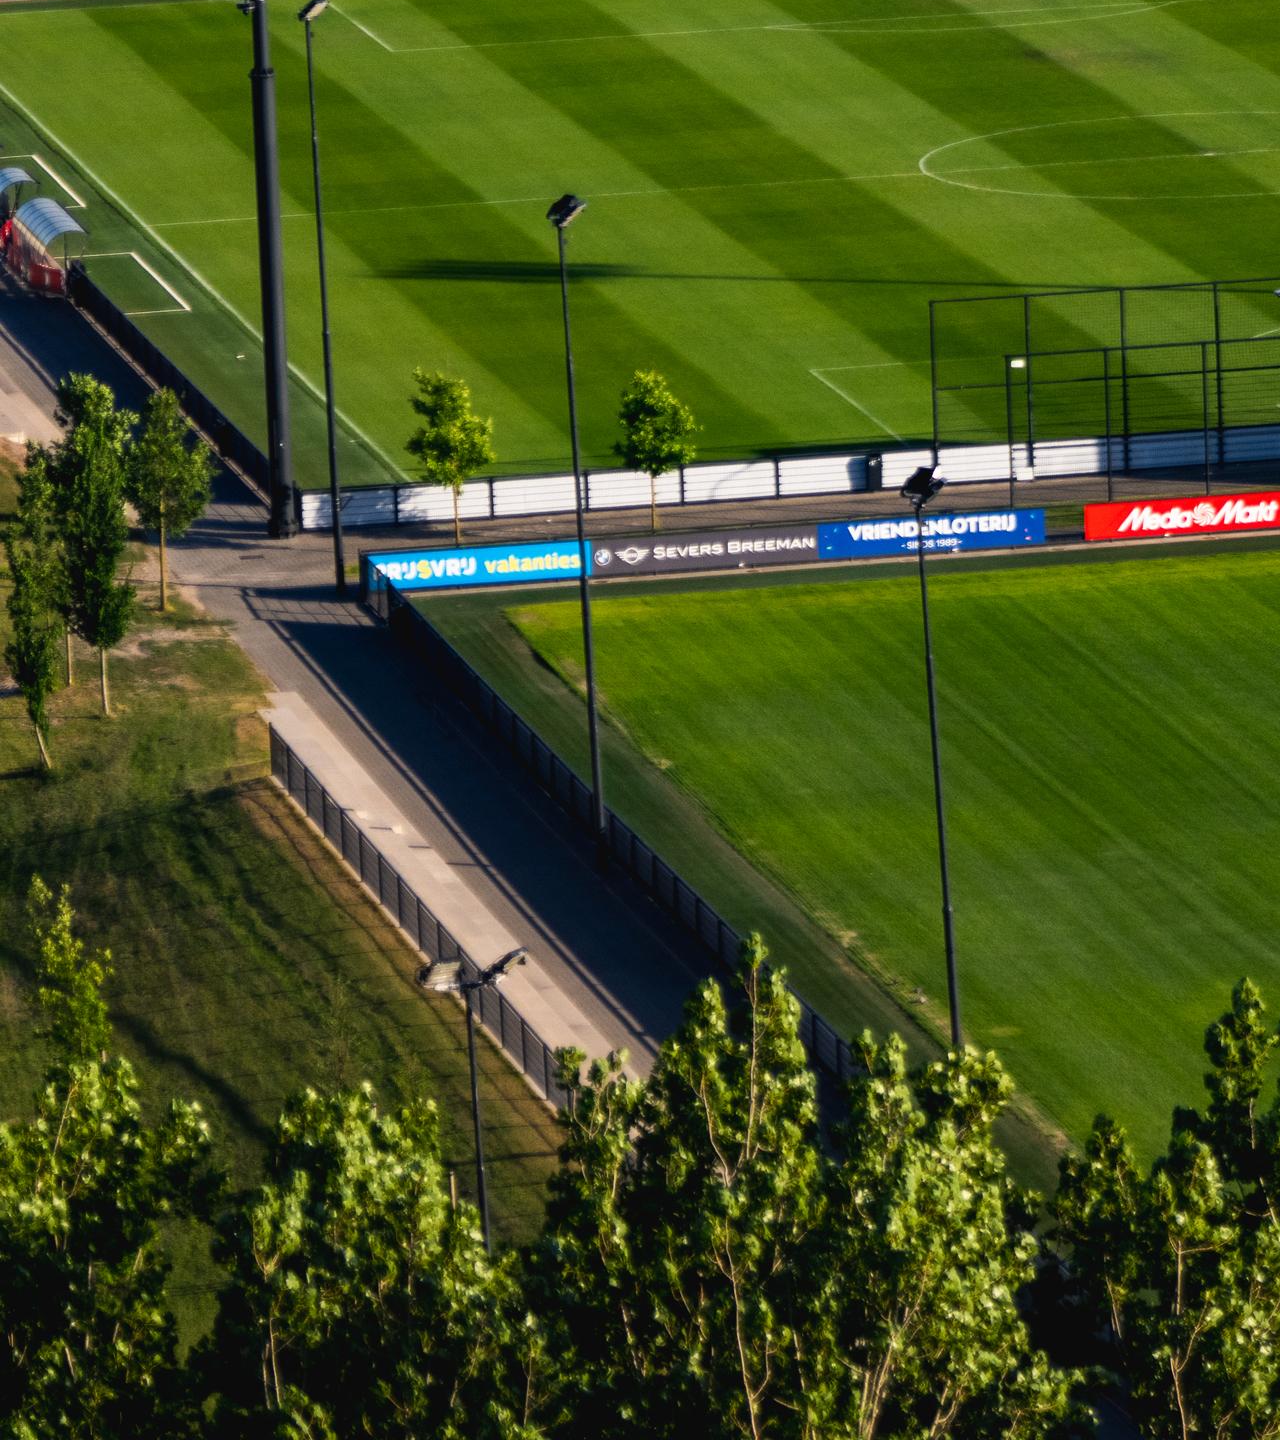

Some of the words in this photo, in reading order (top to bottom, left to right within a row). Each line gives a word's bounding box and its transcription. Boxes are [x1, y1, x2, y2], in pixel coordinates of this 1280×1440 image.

[653, 542, 724, 559] SEVERS
[727, 536, 815, 555] BREEMAN
[484, 551, 581, 574] vakanties
